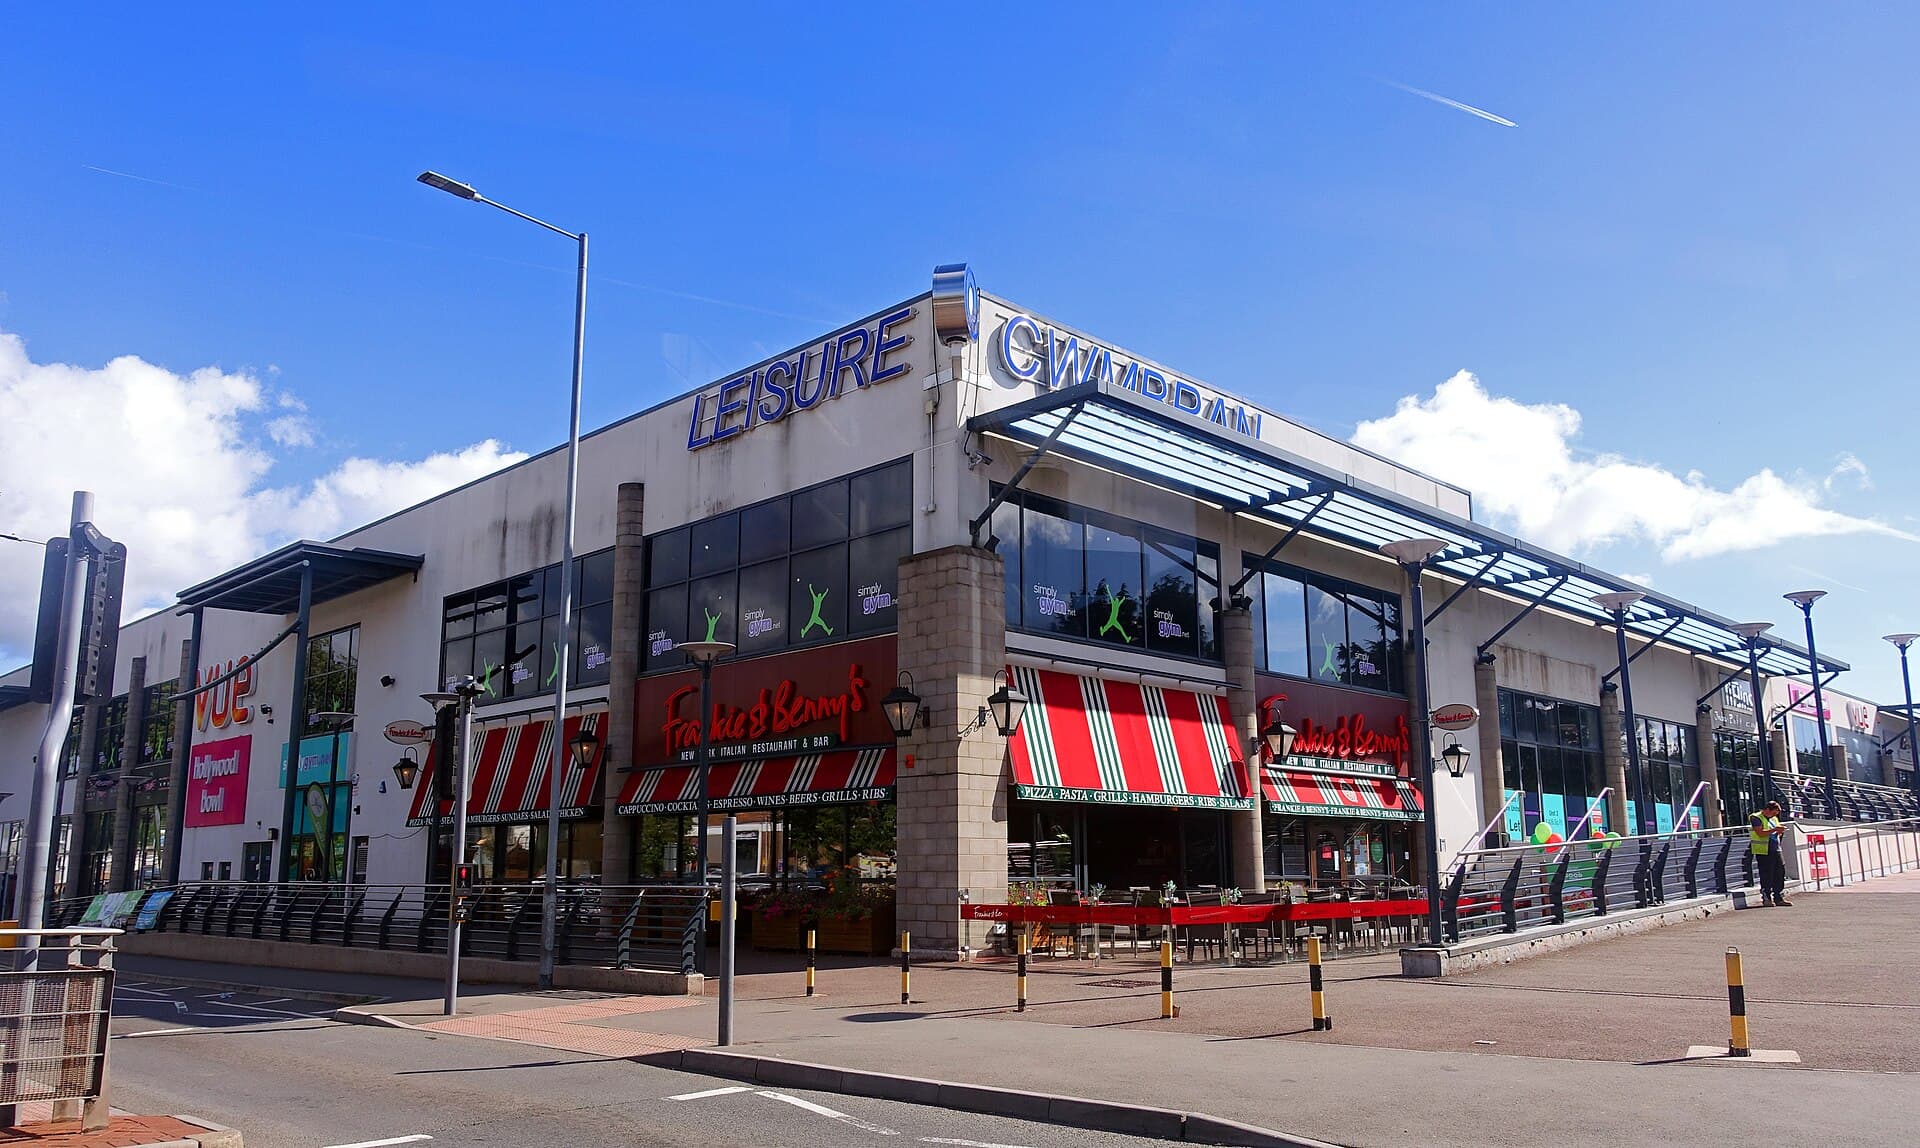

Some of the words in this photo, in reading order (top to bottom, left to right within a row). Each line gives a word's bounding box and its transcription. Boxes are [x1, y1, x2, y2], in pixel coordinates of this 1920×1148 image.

[687, 306, 917, 451] LEISURE
[857, 581, 881, 597] simply
[1033, 582, 1057, 598] simply
[744, 607, 765, 621] simply
[1153, 608, 1173, 621] simply
[648, 628, 667, 641] simply
[584, 644, 600, 655] simply
[662, 683, 747, 757] Frakie
[772, 663, 870, 742] Benny's
[681, 750, 695, 761] NEW
[720, 745, 746, 757] ITALIAN
[752, 739, 797, 754] RESTAURANT
[802, 738, 809, 748] &
[813, 735, 829, 747] BAR
[1352, 712, 1409, 768] Benny's
[1302, 757, 1316, 766] YORK
[1320, 759, 1340, 769] ITALIAN
[1343, 761, 1375, 773] RESTAURANT
[618, 803, 664, 815] CAPPUCCINO
[667, 801, 698, 813] COCKTA
[713, 797, 753, 809] ESPRESSO
[757, 794, 786, 806] WINES
[789, 792, 818, 804] BEERS
[822, 789, 857, 801] GRILLS
[861, 787, 886, 799] RIBS
[1024, 786, 1055, 799] PIZZA
[1058, 788, 1088, 801] PASTA
[1093, 790, 1128, 803] GRILLS
[1132, 792, 1195, 806] HAMBURGERS
[1198, 796, 1217, 807] RIBS
[1219, 798, 1251, 809] SALADS
[466, 814, 501, 824] AMBURGERS
[501, 811, 529, 822] SUNDAES
[559, 808, 585, 818] HICKEN
[1273, 804, 1300, 812] FRANKIE
[1330, 806, 1356, 815] FRANKIE
